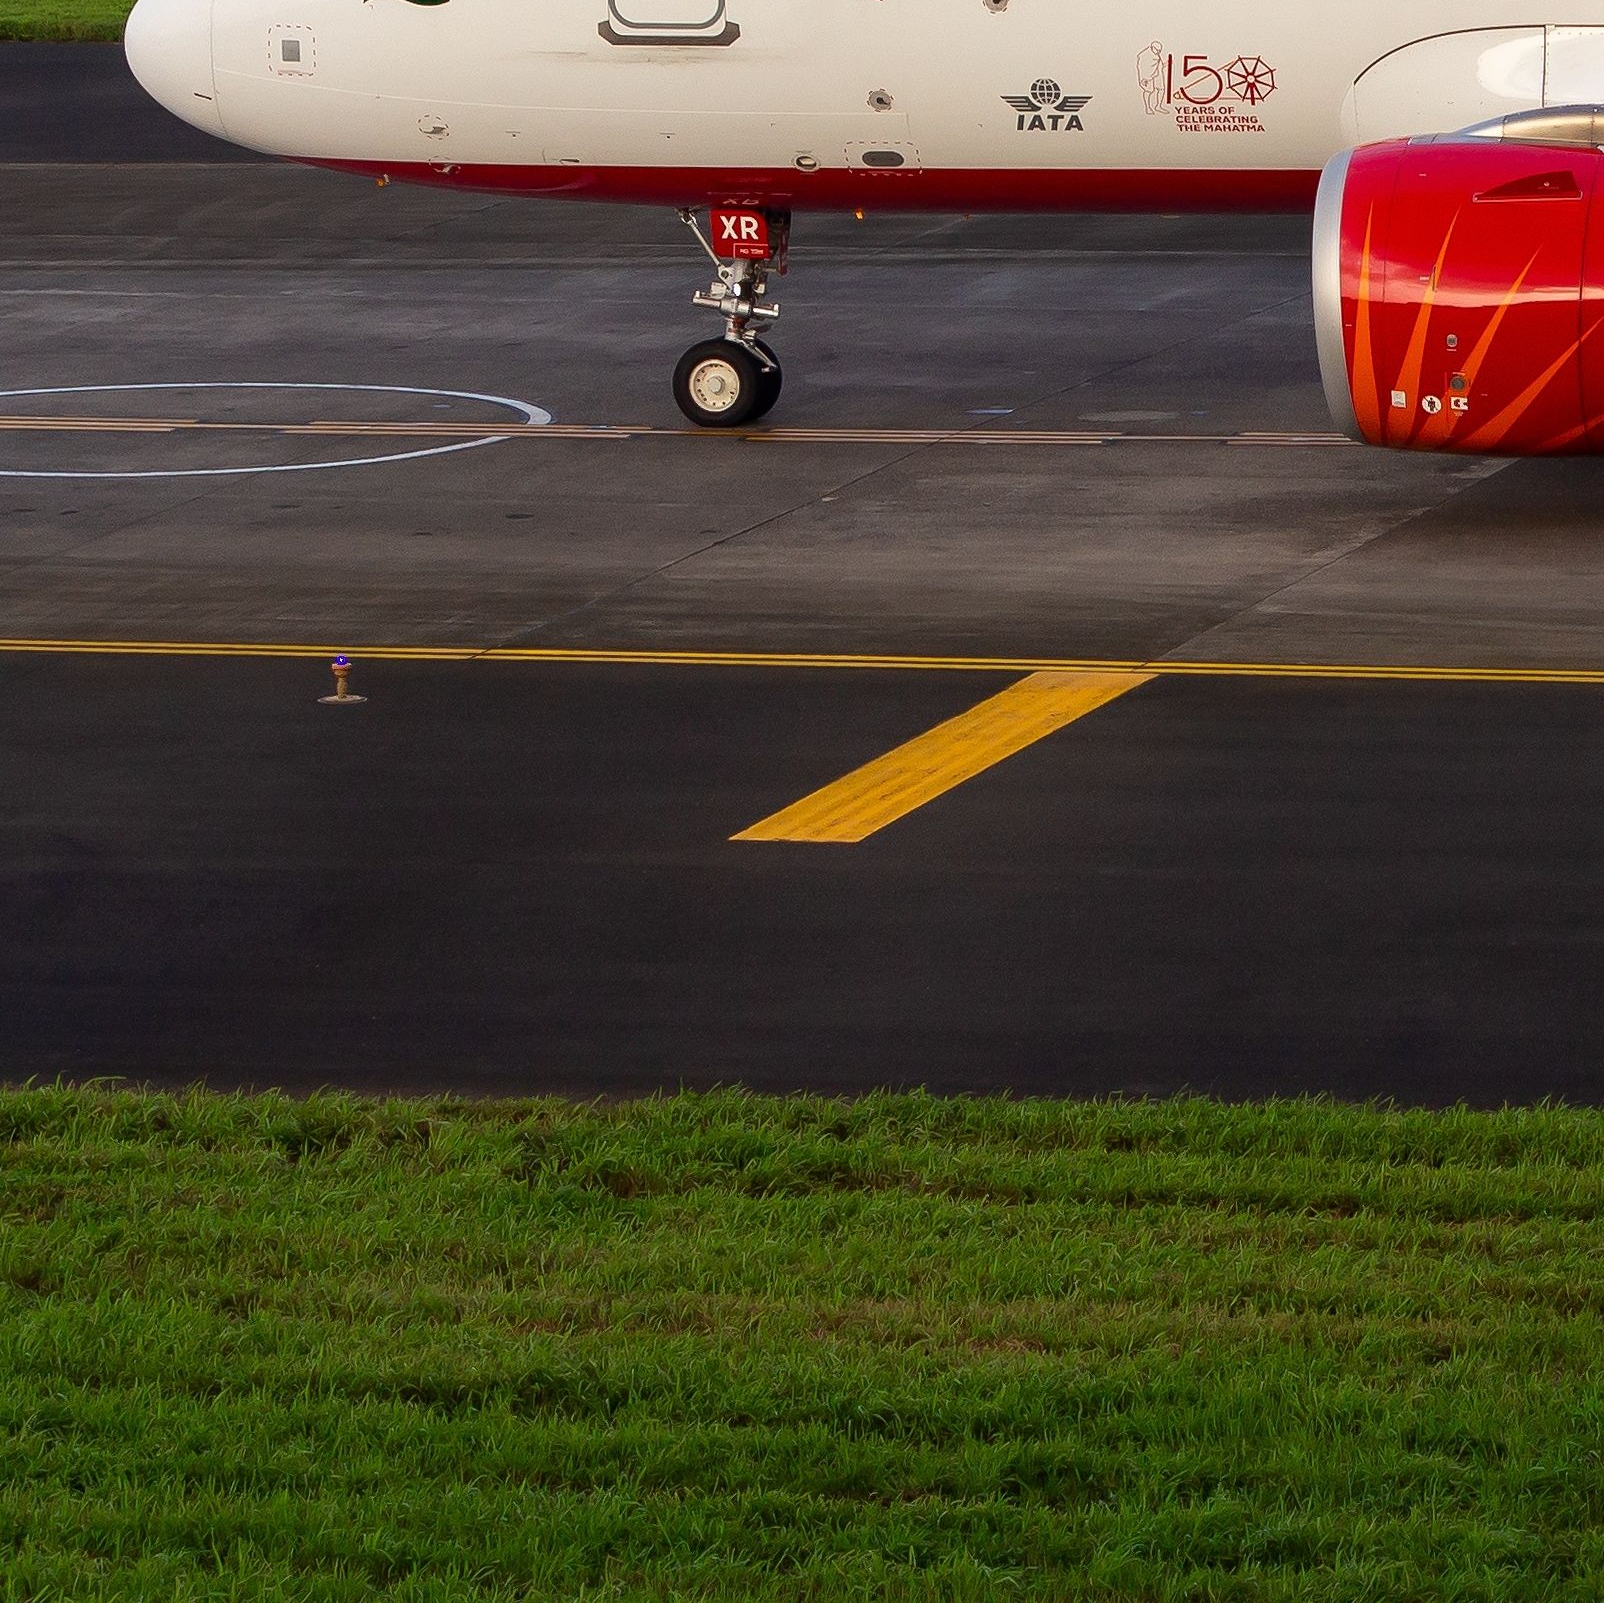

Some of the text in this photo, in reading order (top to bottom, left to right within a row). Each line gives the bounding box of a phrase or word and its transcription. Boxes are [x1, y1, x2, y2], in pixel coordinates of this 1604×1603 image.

[1175, 106, 1236, 115] YEARS OF
[1016, 114, 1084, 132] IATA
[1176, 115, 1259, 124] CELEBRATING
[1177, 124, 1266, 133] THE MAHATMA
[719, 215, 760, 241] XR
